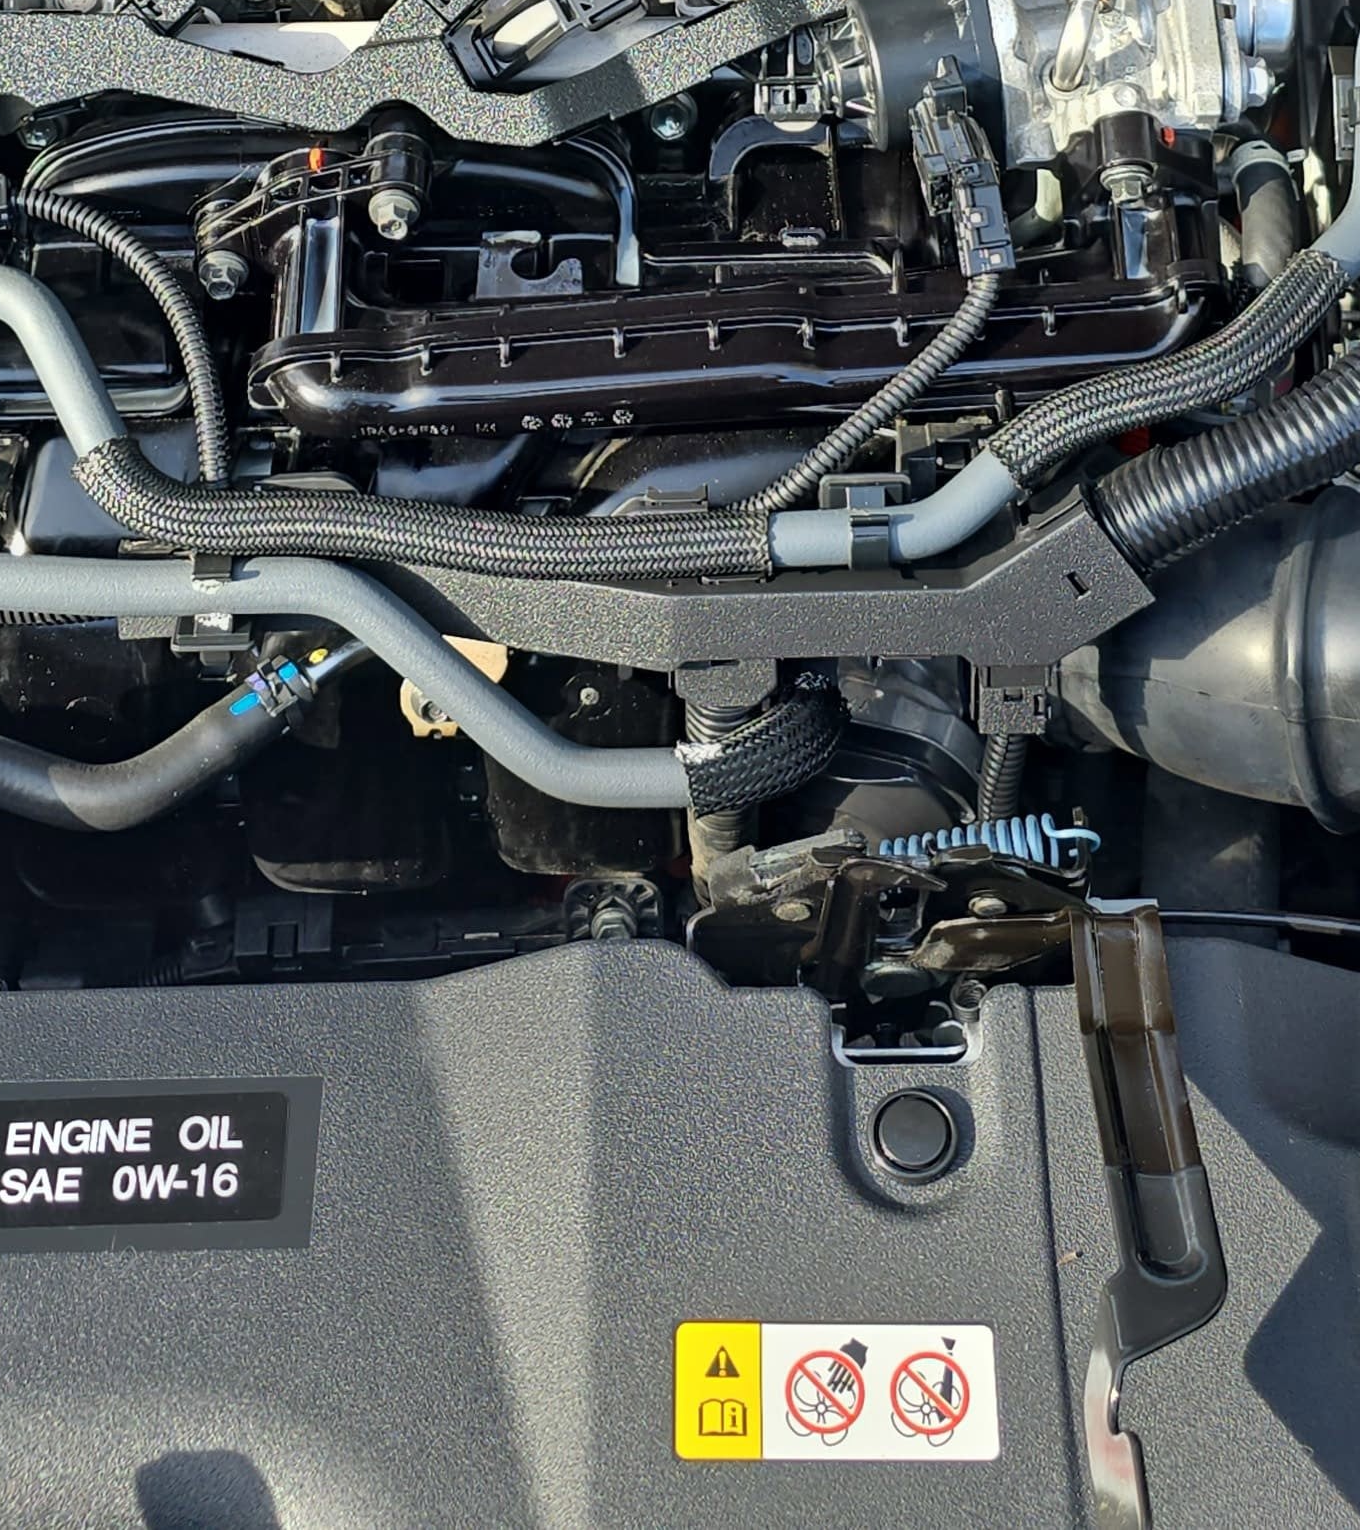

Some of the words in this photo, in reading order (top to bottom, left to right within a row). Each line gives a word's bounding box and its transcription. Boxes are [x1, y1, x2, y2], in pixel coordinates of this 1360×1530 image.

[4, 1117, 154, 1156] ENGINE
[177, 1115, 244, 1151] OIL
[111, 1161, 239, 1201] 0W-16
